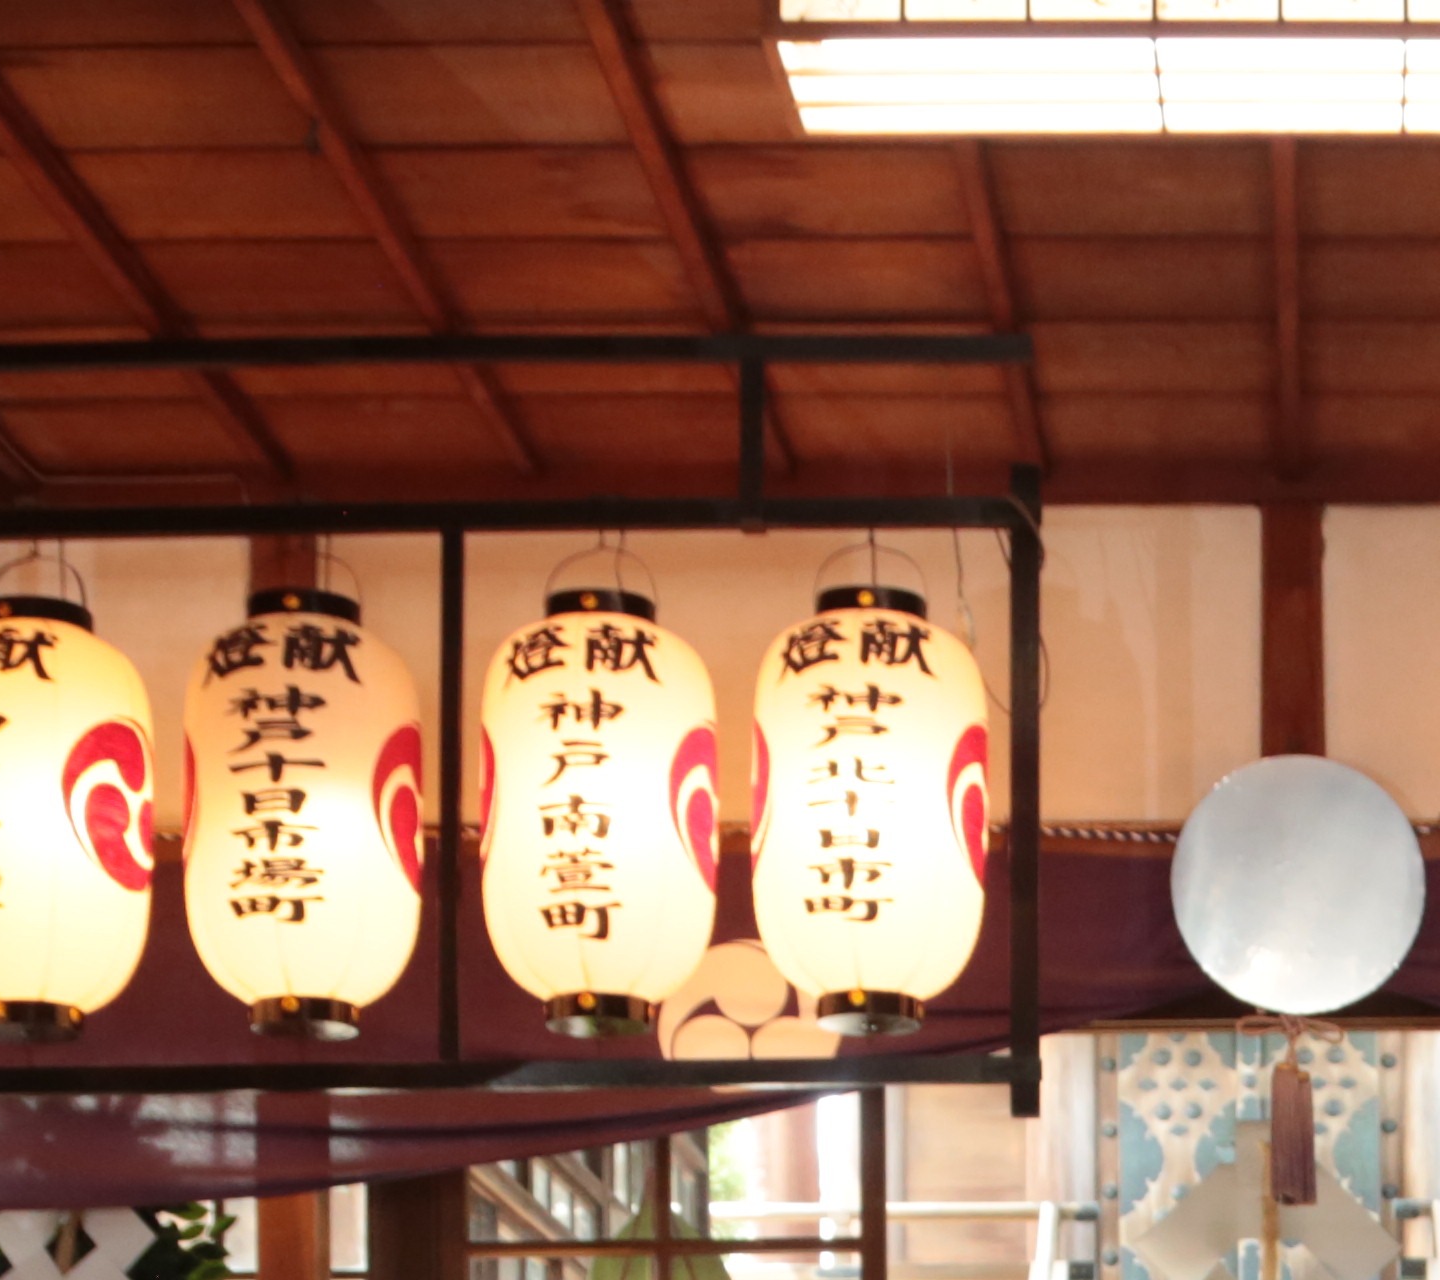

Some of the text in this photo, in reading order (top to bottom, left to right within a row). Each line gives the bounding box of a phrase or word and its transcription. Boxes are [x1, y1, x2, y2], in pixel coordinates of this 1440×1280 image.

[226, 684, 328, 923] 神戸十日市場町
